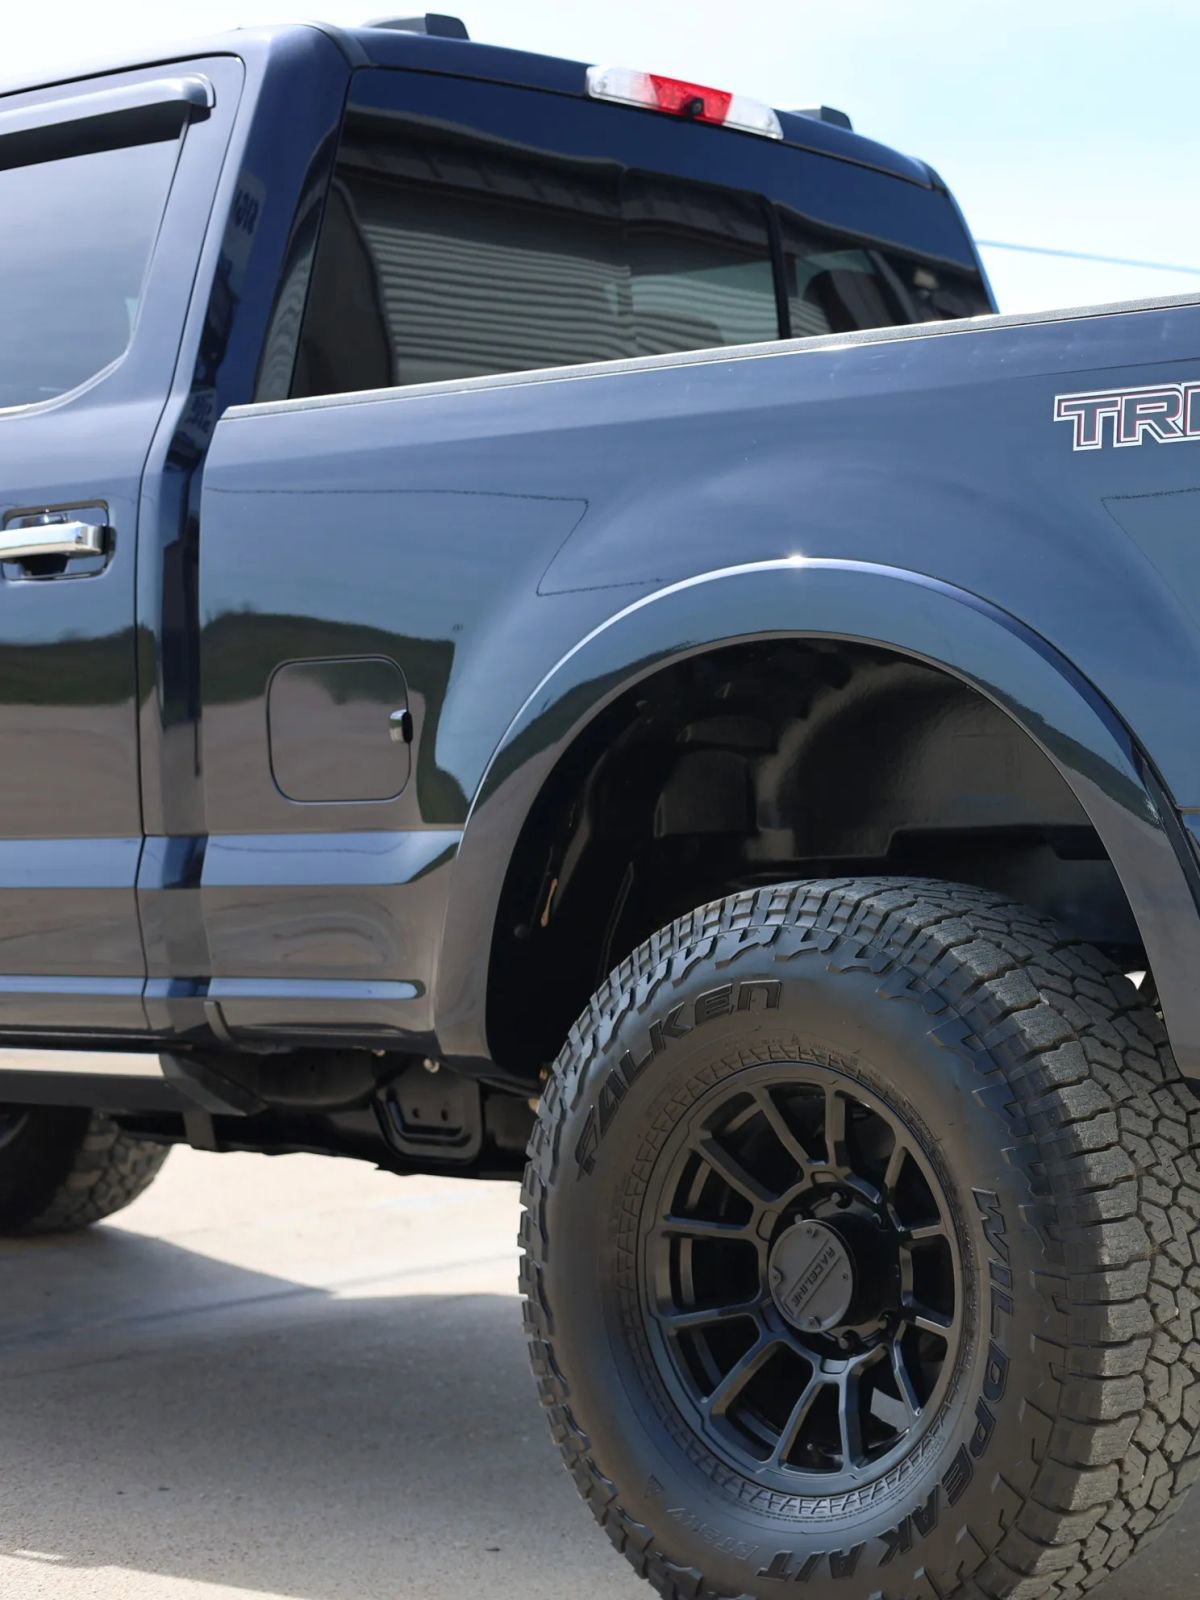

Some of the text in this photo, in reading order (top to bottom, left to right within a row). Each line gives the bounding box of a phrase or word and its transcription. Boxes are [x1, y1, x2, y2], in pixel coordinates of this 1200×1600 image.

[575, 979, 783, 1182] FALKEN
[874, 1187, 1014, 1567] WILDPEAK
[755, 1540, 868, 1583] A/T
